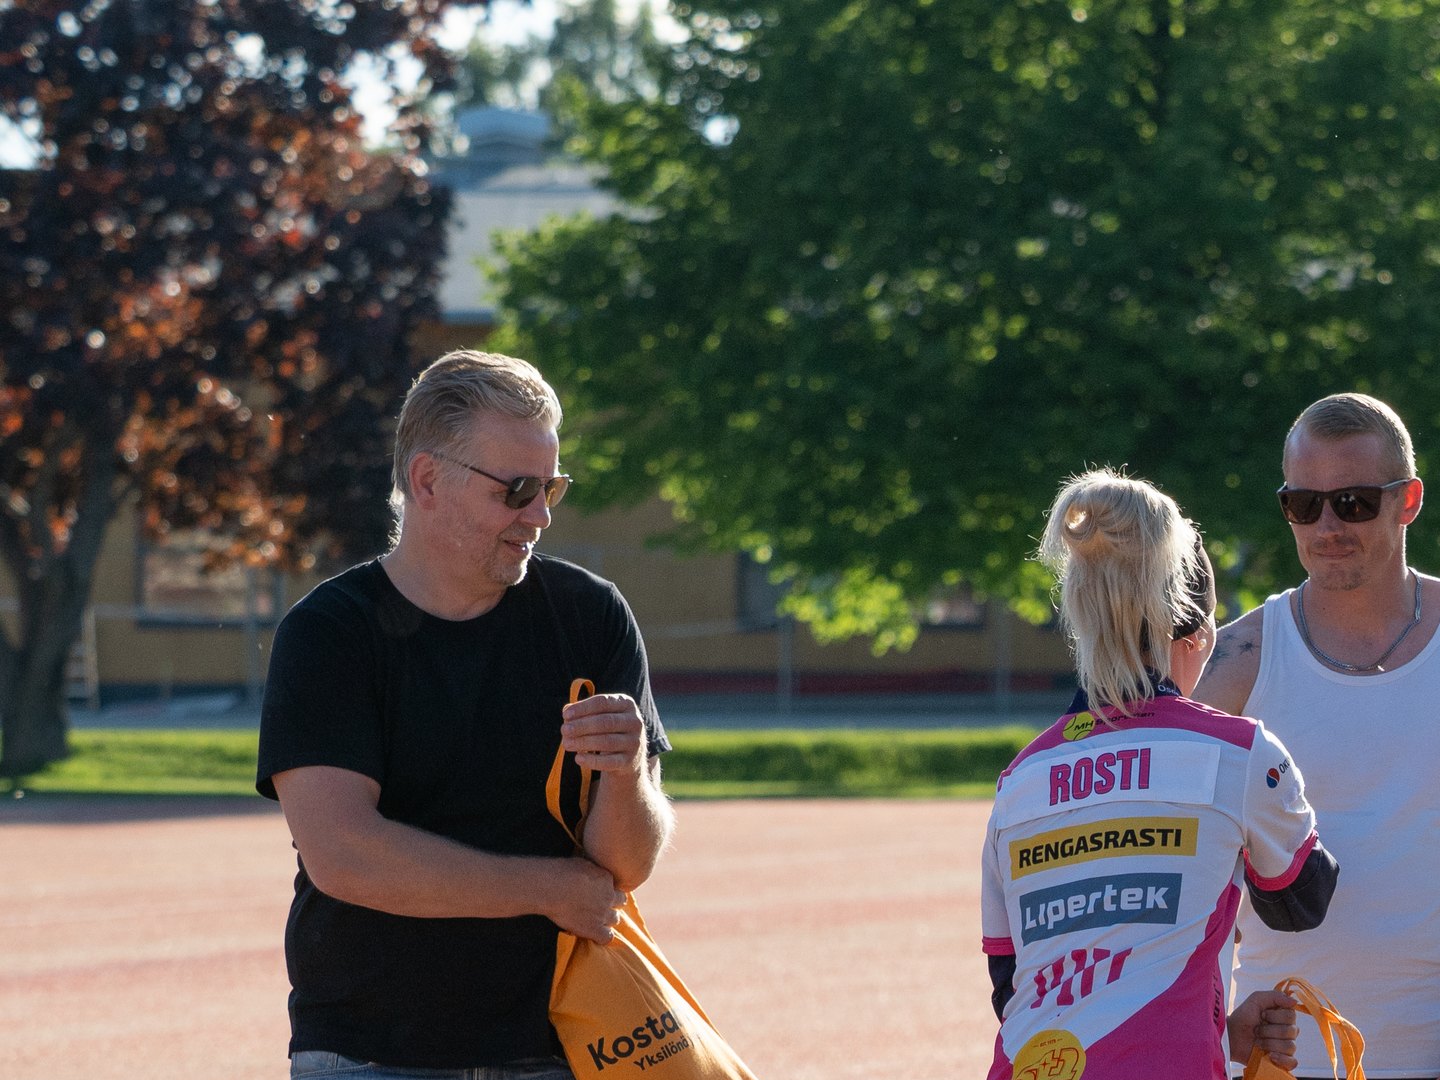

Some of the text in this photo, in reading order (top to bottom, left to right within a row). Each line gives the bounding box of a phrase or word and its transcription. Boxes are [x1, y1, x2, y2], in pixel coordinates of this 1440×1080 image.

[1049, 748, 1151, 806] ROSTI
[1018, 828, 1182, 869] RENGASRASTI
[587, 1010, 681, 1071] Kosta
[633, 1035, 689, 1071] Yksilönä
